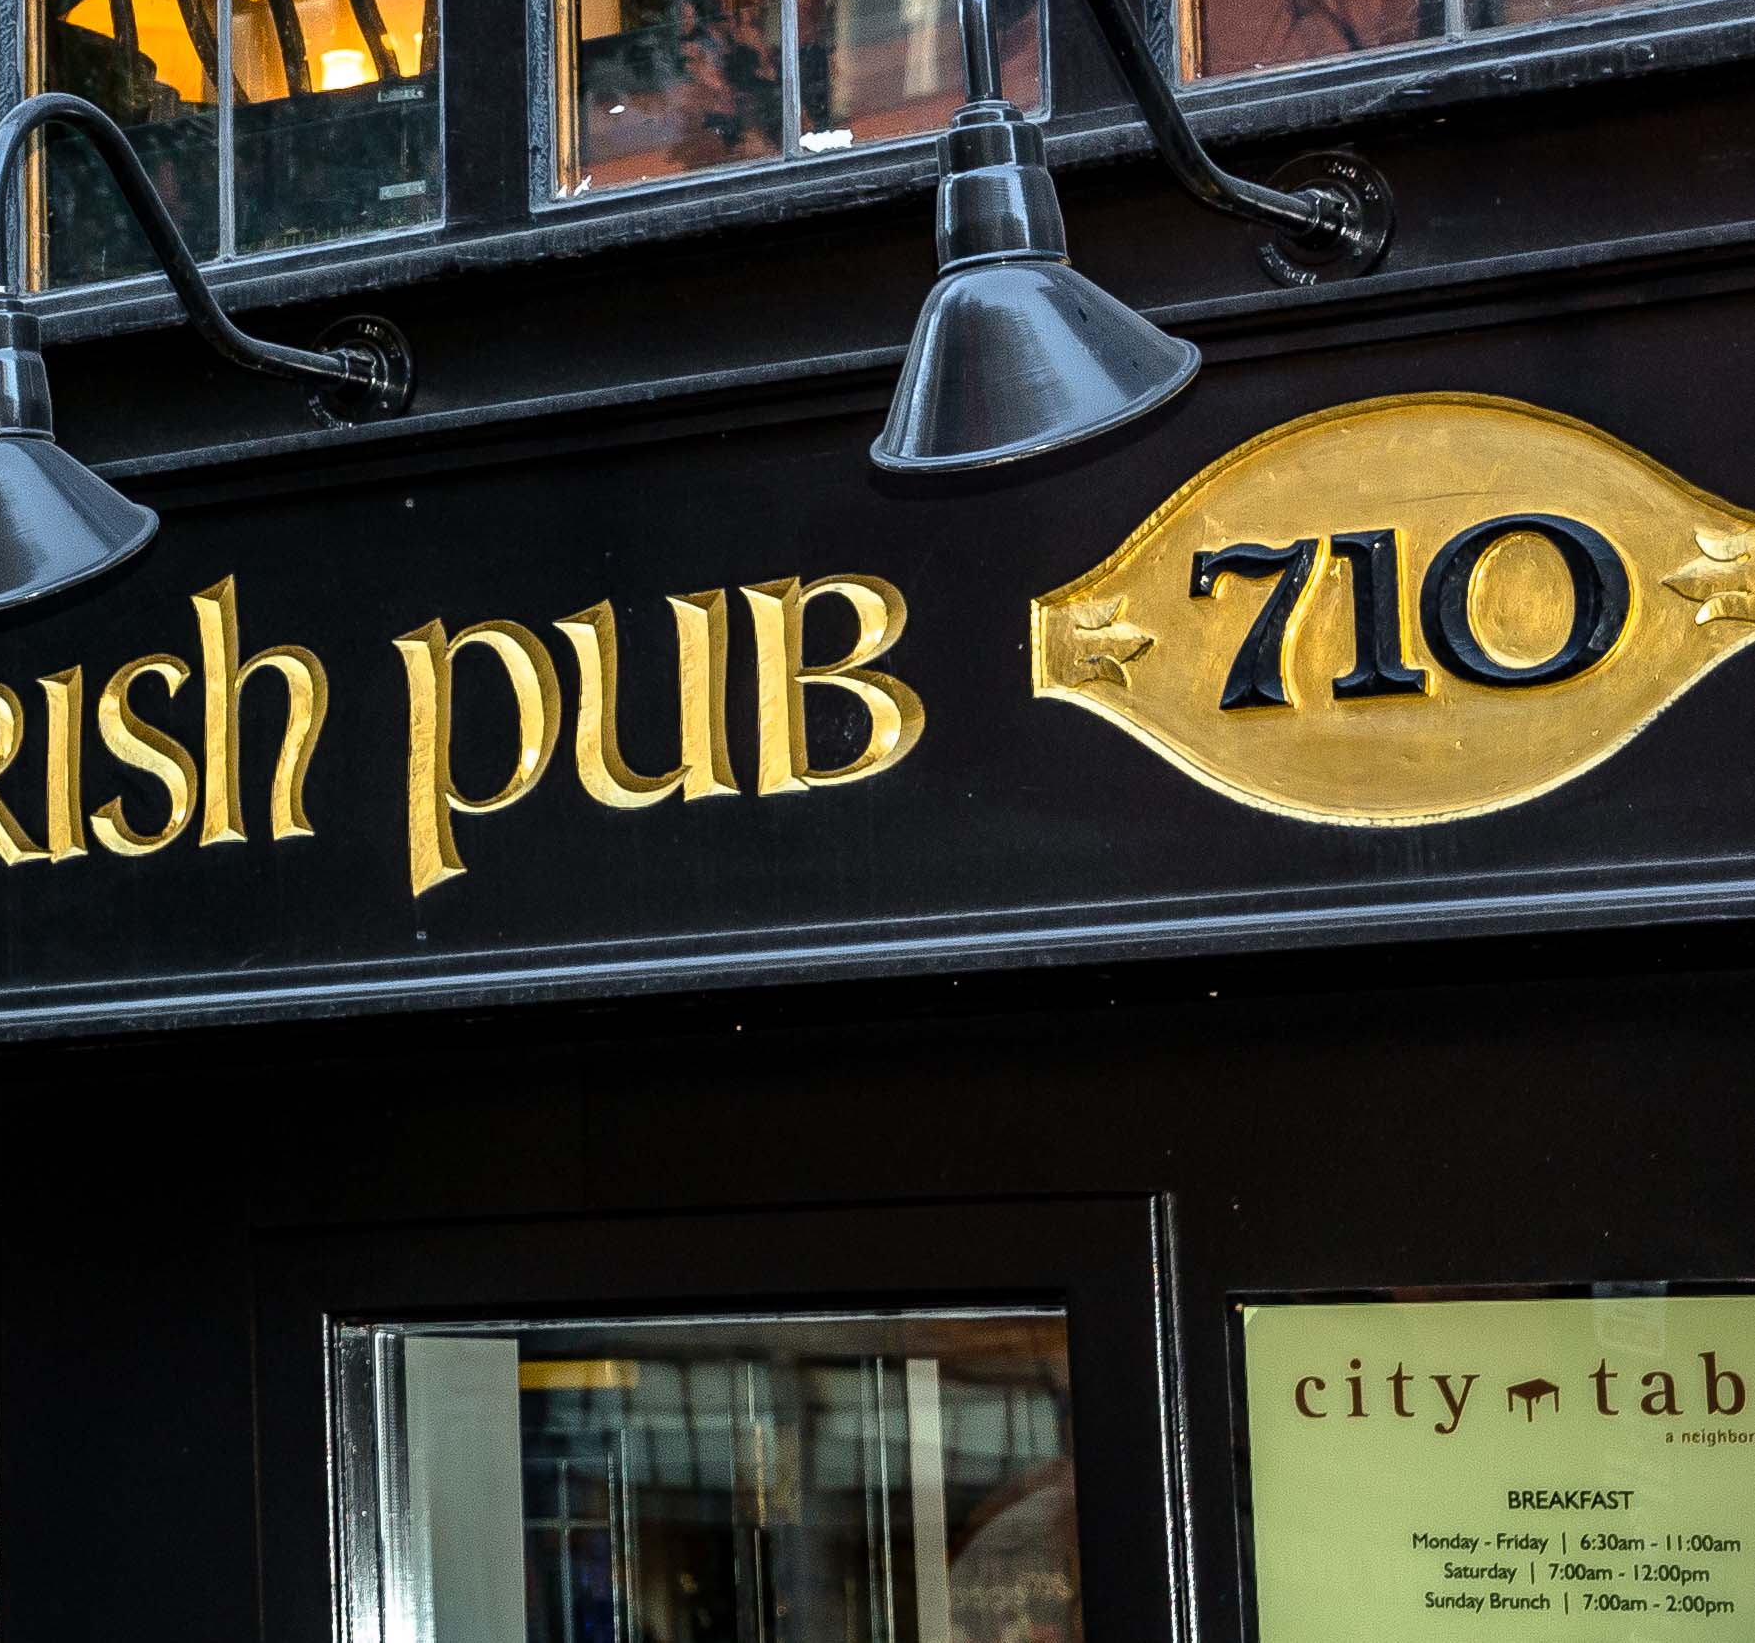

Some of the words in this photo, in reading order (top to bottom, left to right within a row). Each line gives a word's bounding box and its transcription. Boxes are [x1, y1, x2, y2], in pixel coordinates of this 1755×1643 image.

[1189, 512, 1633, 712] 710
[1294, 1357, 1481, 1435] city
[1588, 1350, 1747, 1416] tab
[1665, 1432, 1674, 1443] a
[1507, 1490, 1635, 1511] BREAKFAST
[1412, 1532, 1479, 1555] Monday
[1496, 1532, 1549, 1555] Friday
[1580, 1533, 1645, 1552] 6:30am
[1666, 1533, 1741, 1553] 11:00am
[1444, 1561, 1518, 1585] Saturday
[1548, 1563, 1613, 1581] 7:00am
[1633, 1564, 1710, 1587] 12:00pm
[1424, 1591, 1485, 1614] Sunday
[1489, 1591, 1551, 1611] Brunch
[1582, 1593, 1648, 1612] 7:00am
[1665, 1594, 1735, 1618] 2:00pm
